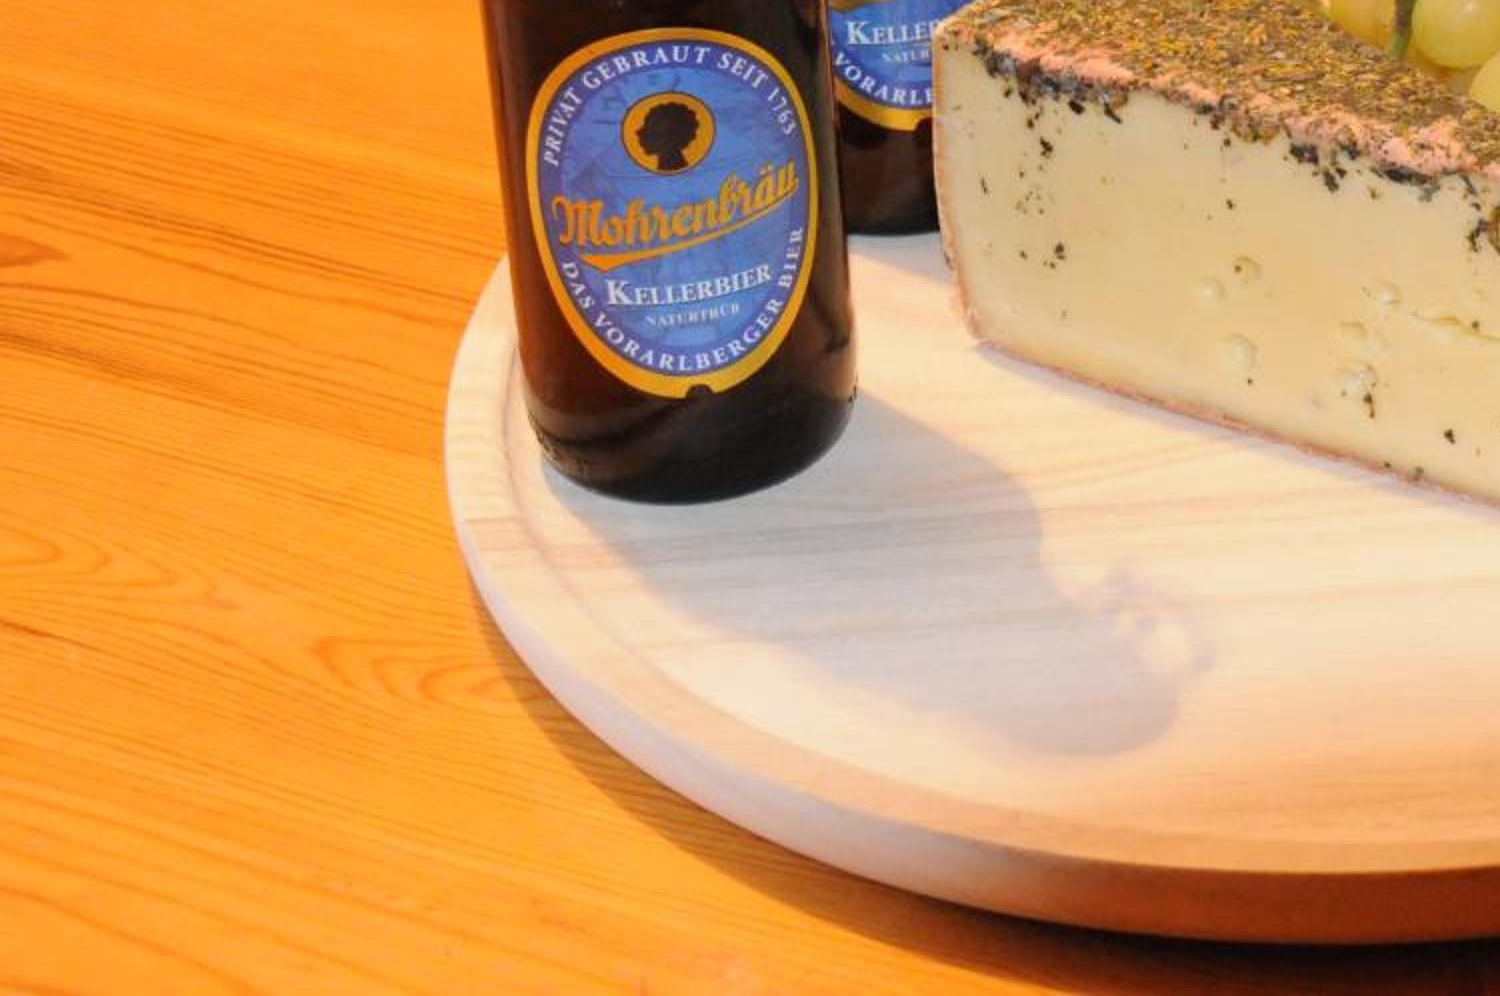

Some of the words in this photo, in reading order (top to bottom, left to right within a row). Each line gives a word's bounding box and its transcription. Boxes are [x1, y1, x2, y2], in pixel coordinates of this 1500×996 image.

[543, 86, 583, 168] PRIVAT
[583, 46, 711, 88] GEBRAUT
[717, 50, 769, 89] SEIT
[767, 85, 797, 136] 1763
[552, 157, 800, 247] Mohrenbräu
[561, 260, 596, 310] DAS
[594, 298, 784, 372] VORARLBERGER
[778, 226, 804, 289] BIER
